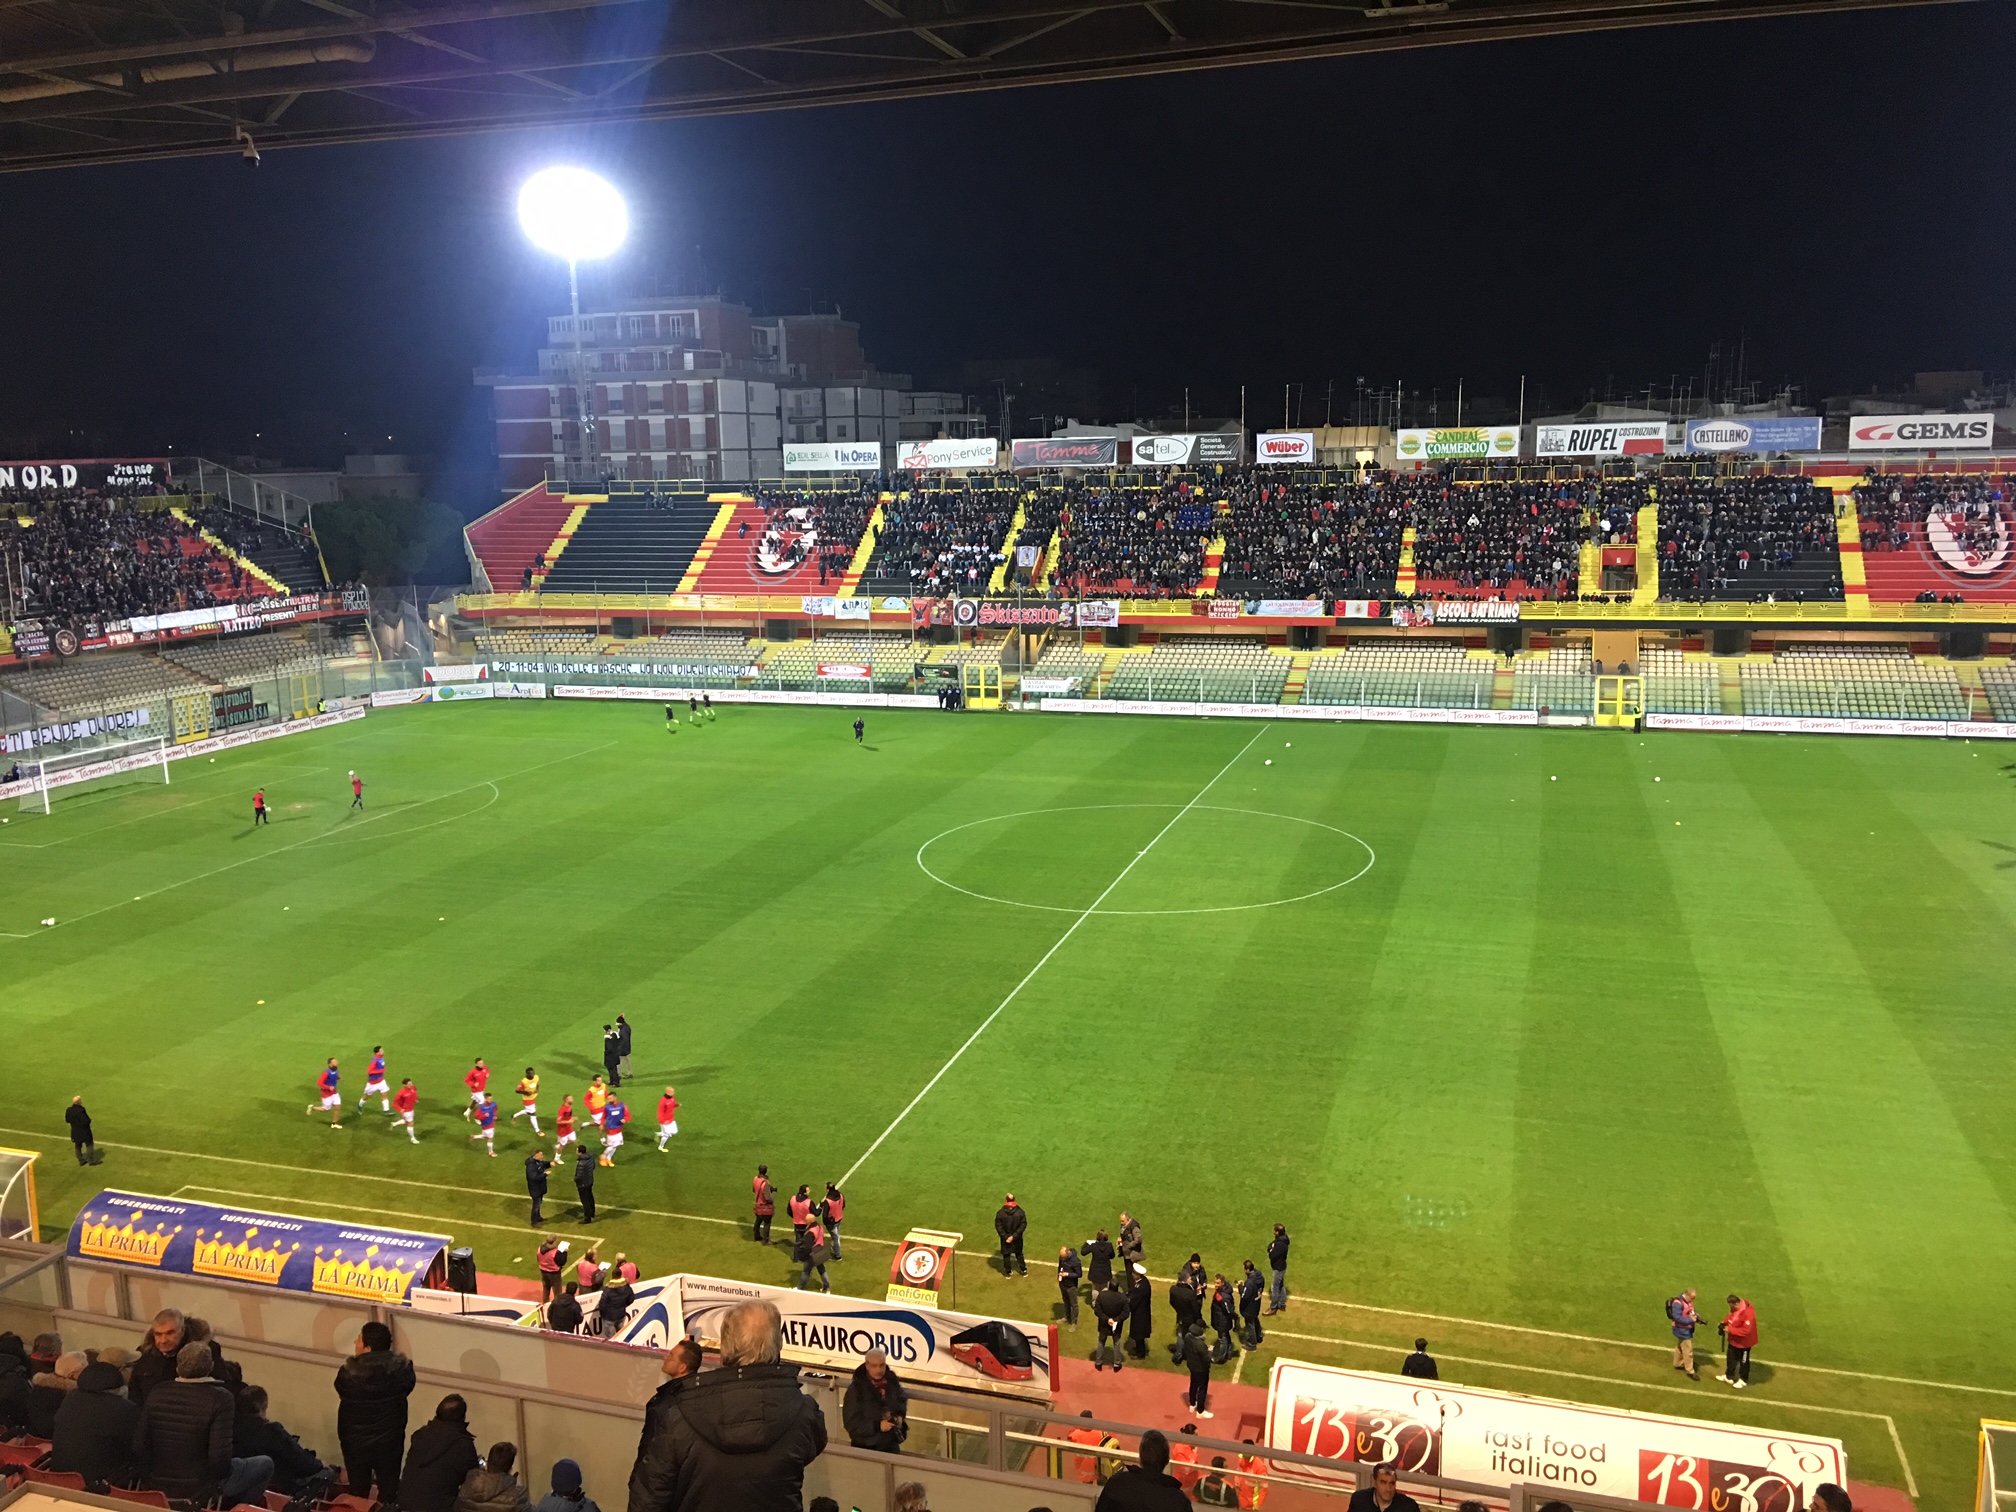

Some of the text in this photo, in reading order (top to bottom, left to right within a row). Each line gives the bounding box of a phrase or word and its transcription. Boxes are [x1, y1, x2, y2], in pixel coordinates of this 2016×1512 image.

[1618, 426, 1660, 436] COSTRUZIONI
[1694, 429, 1748, 444] CASTELLANO
[1896, 422, 1988, 440] GEMS
[1265, 440, 1304, 453] Wüber
[1567, 428, 1618, 452] RUPEL
[1028, 442, 1101, 460] Tamma
[1138, 444, 1170, 454] satel
[1426, 442, 1488, 454] COMMERCIO
[0, 464, 78, 489] NORD
[292, 594, 319, 606] ULTRAS
[262, 610, 296, 622] PRESENTI
[978, 602, 1060, 625] Skizzato
[1436, 602, 1519, 618] ASCOLI SATRIANO
[223, 616, 262, 634] MATTEO
[562, 664, 589, 673] DELLE
[657, 664, 674, 674] NON
[555, 686, 617, 698] Tamma Tamma
[620, 688, 682, 699] Tamma Tamma
[718, 690, 748, 700] Tamma
[1044, 700, 1116, 710] Tamma Tamma
[1118, 702, 1194, 712] Tamma Tamma
[1198, 704, 1276, 714] Tamma Tamma
[1282, 706, 1360, 716] Tamma Tamma
[311, 708, 364, 727] Tamma Tamma
[1366, 708, 1446, 718] Tamma Tamma
[1452, 710, 1536, 722] Tamma Tamma
[1652, 715, 1742, 727] Tamma Tamma
[1750, 718, 1842, 730] Tamma Tamma
[1848, 720, 1946, 734] Tamma Tamma
[252, 720, 310, 740] Tamma Tamma
[1950, 724, 1998, 734] Tamma
[187, 732, 250, 754] Tamma Tamma
[115, 756, 150, 771] Tamma
[76, 763, 113, 780] Tamma
[0, 781, 32, 796] amma
[108, 1198, 186, 1215] SUPERMERCATI
[220, 1214, 302, 1232] SUPERMERCATI
[86, 1232, 160, 1256] LA PRIMA
[338, 1230, 425, 1250] SUPERMERCATI
[199, 1249, 276, 1274] LA PRIMA
[318, 1268, 400, 1294] LA PRIMA
[686, 1281, 762, 1298] www.metaurobus.it
[890, 1288, 936, 1302] mafiGraf
[1484, 1426, 1606, 1463] fast food
[1492, 1450, 1598, 1486] italiano
